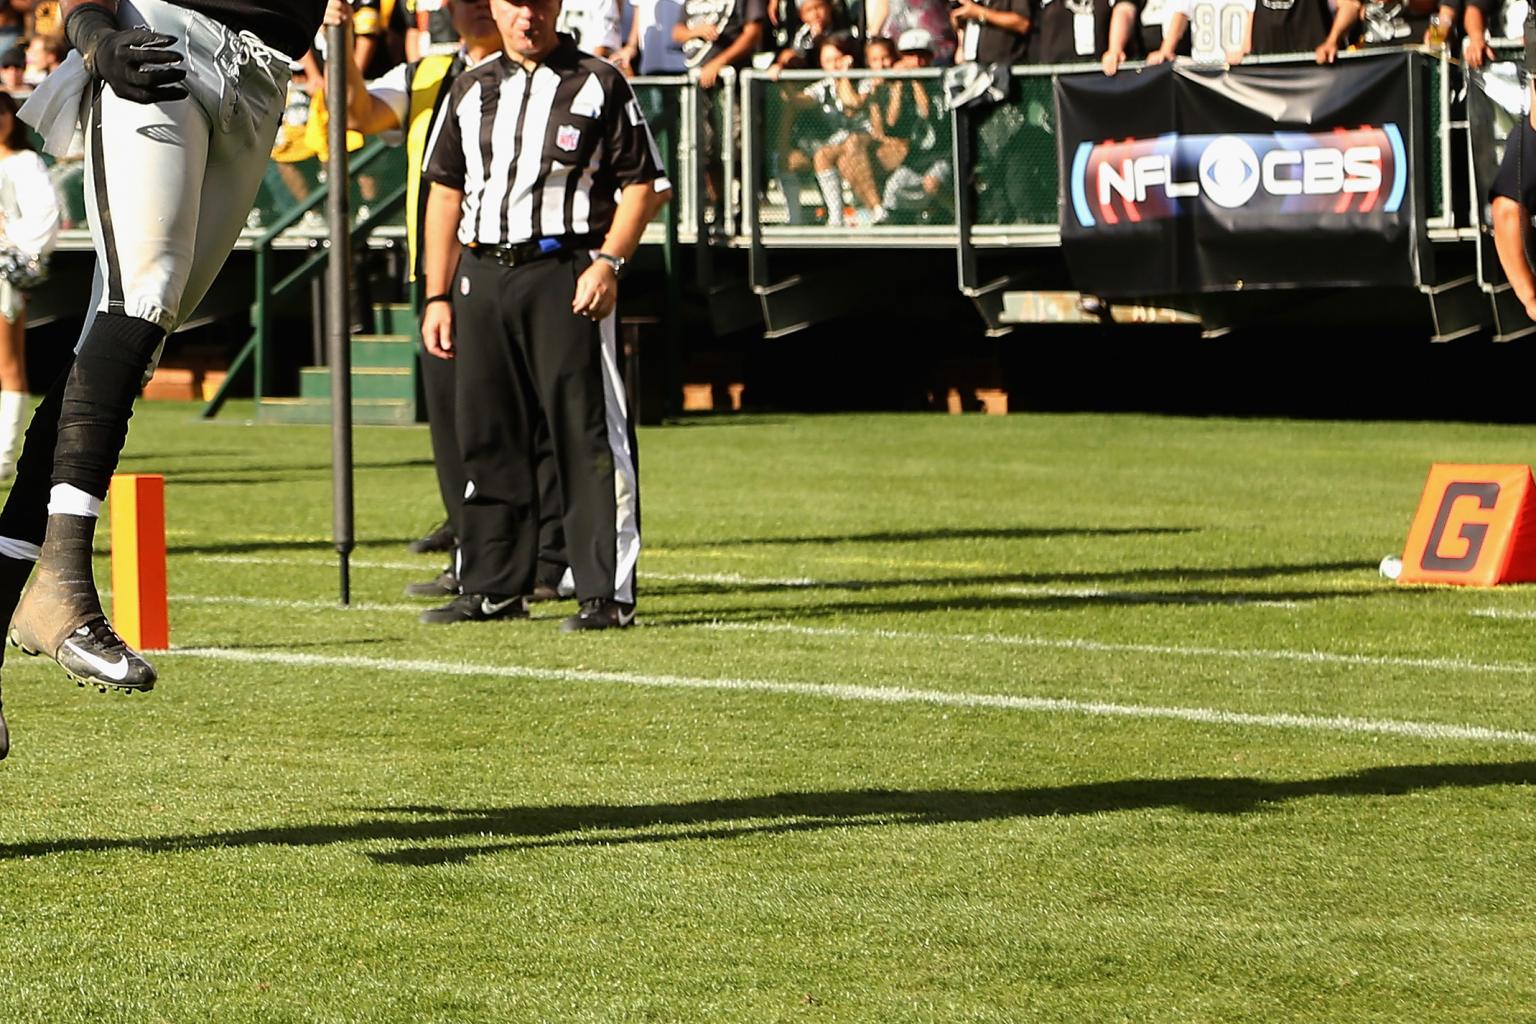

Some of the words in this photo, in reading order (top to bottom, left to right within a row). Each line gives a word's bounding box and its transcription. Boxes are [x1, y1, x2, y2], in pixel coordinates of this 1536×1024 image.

[1191, 2, 1250, 54] 80
[1098, 153, 1200, 206] NFL
[1262, 145, 1383, 196] CBS
[1420, 481, 1501, 574] G
